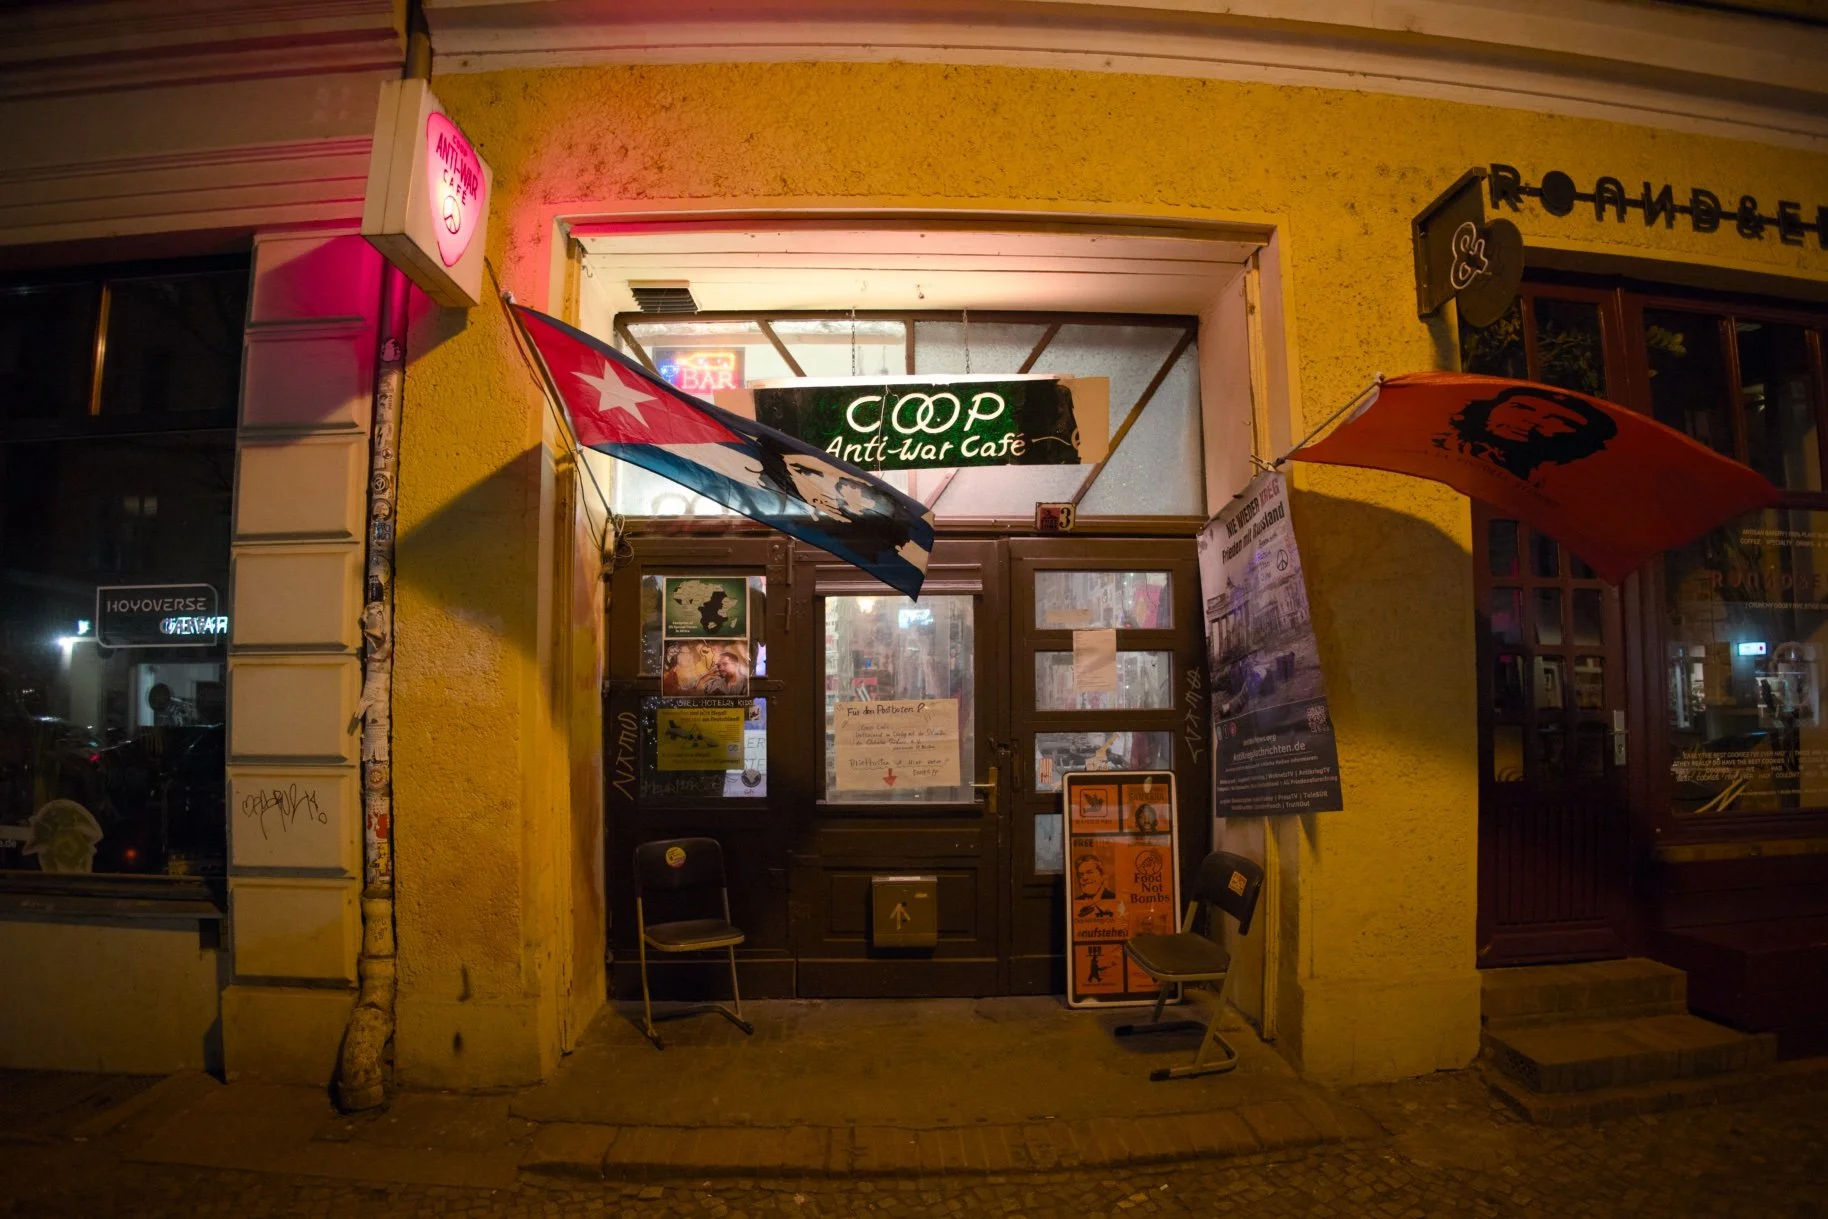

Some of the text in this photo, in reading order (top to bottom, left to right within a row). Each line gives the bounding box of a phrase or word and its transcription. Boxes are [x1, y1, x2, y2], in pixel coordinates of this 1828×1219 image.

[436, 132, 479, 201] ANTI-WAR
[443, 169, 467, 206] CAFÉ
[682, 367, 736, 390] BAR
[846, 392, 1005, 434] COOP
[960, 432, 1027, 458] Café
[1059, 507, 1071, 529] 3
[1226, 519, 1239, 539] NIE
[1237, 497, 1261, 529] WIEDER
[1222, 537, 1243, 565] Frieden
[106, 598, 207, 613] HOYOVERSE
[847, 707, 860, 717] Für
[863, 706, 875, 716] den
[1134, 872, 1162, 884] Food
[1141, 883, 1162, 893] Not
[1130, 893, 1169, 904] Bombs
